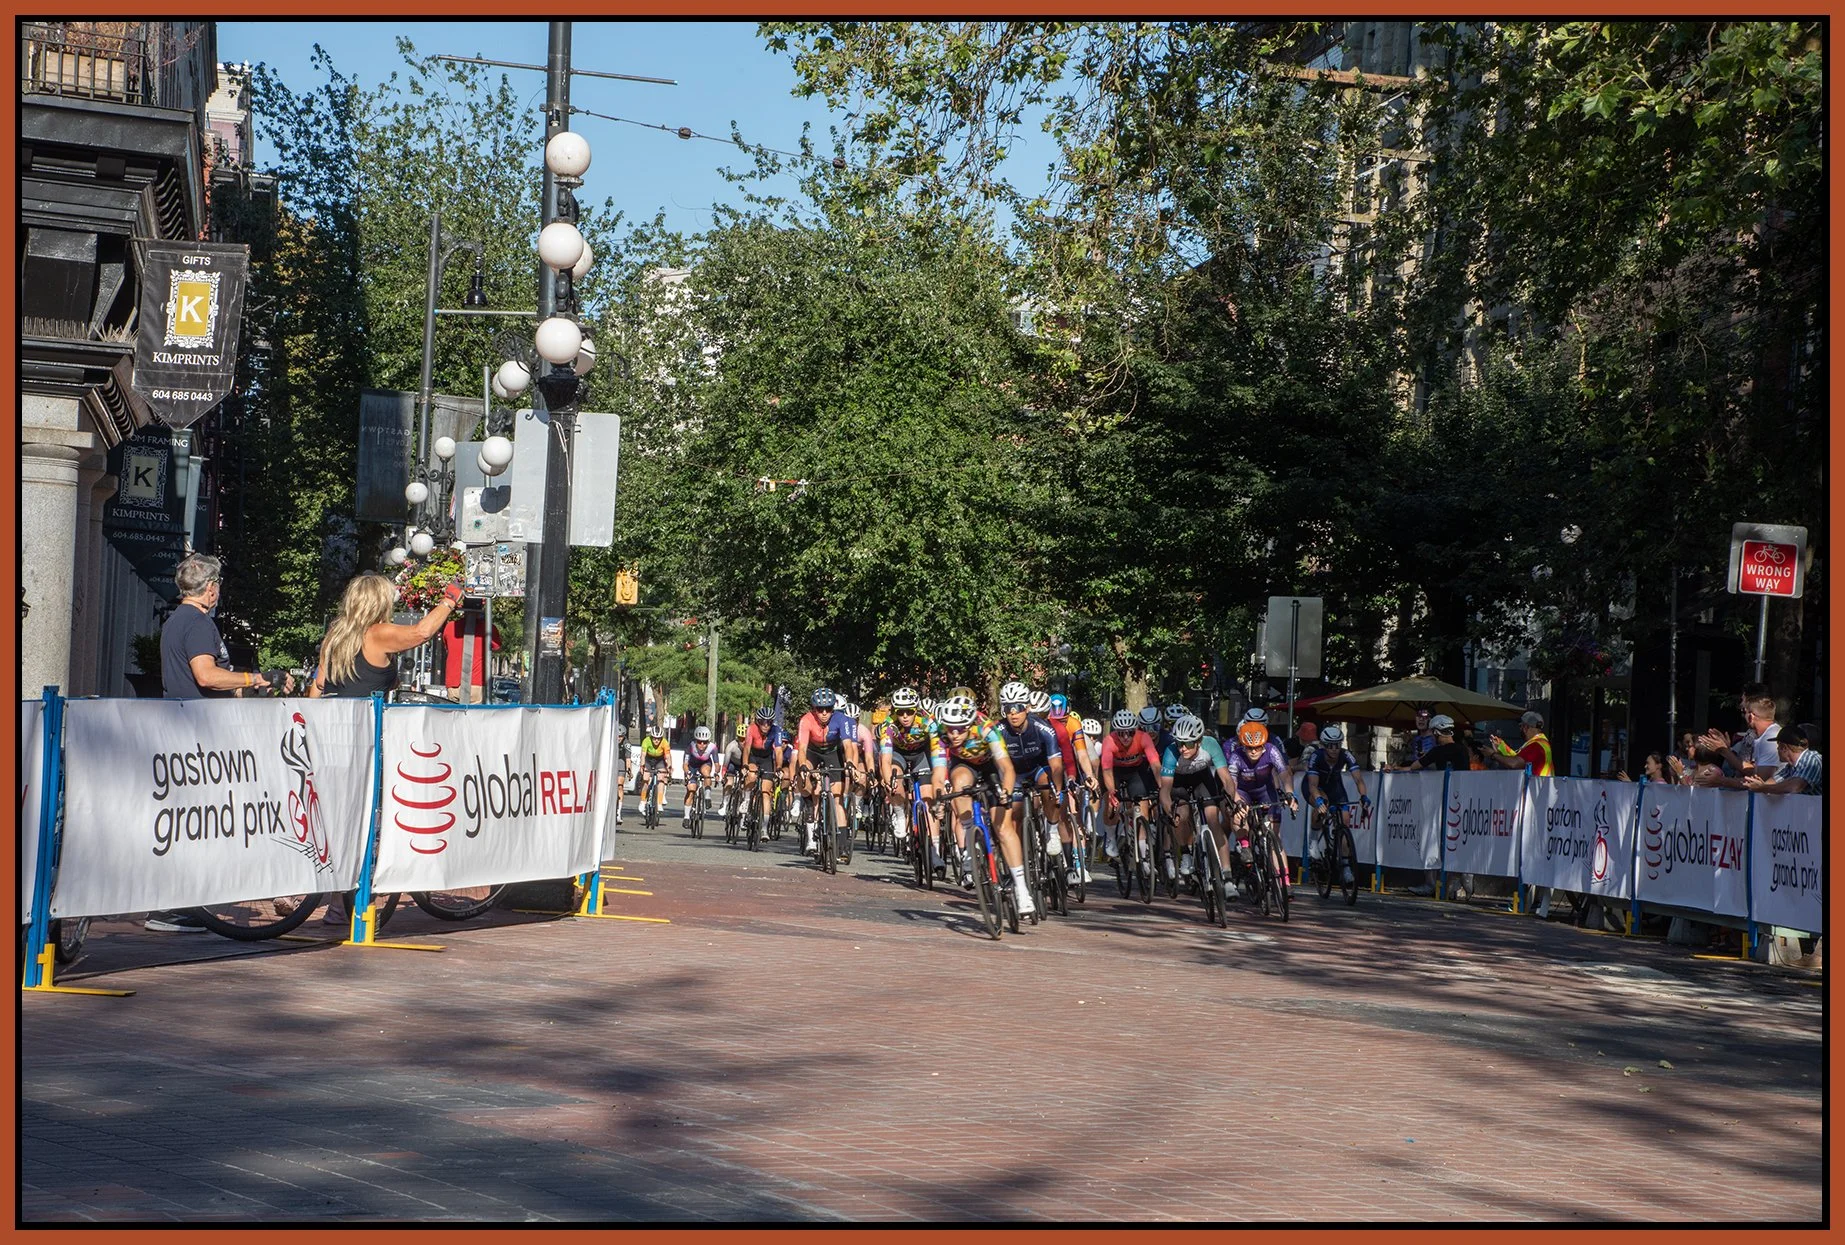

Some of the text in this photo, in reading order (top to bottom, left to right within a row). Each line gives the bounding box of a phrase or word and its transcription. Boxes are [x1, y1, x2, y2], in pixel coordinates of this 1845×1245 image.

[182, 255, 211, 266] GIFTS
[180, 295, 205, 323] K
[152, 351, 220, 366] KIMPRINTS
[152, 389, 213, 402] 604 685 0443
[147, 435, 189, 448] FRAMING
[133, 466, 153, 488] K
[112, 508, 170, 522] KIMPRINTS
[112, 531, 166, 543] 604.685.0443
[1746, 564, 1791, 578] WRONG
[1755, 577, 1781, 590] WAY
[152, 743, 258, 801] gastown
[152, 790, 286, 857] grand prix
[1801, 861, 1819, 897] prix
